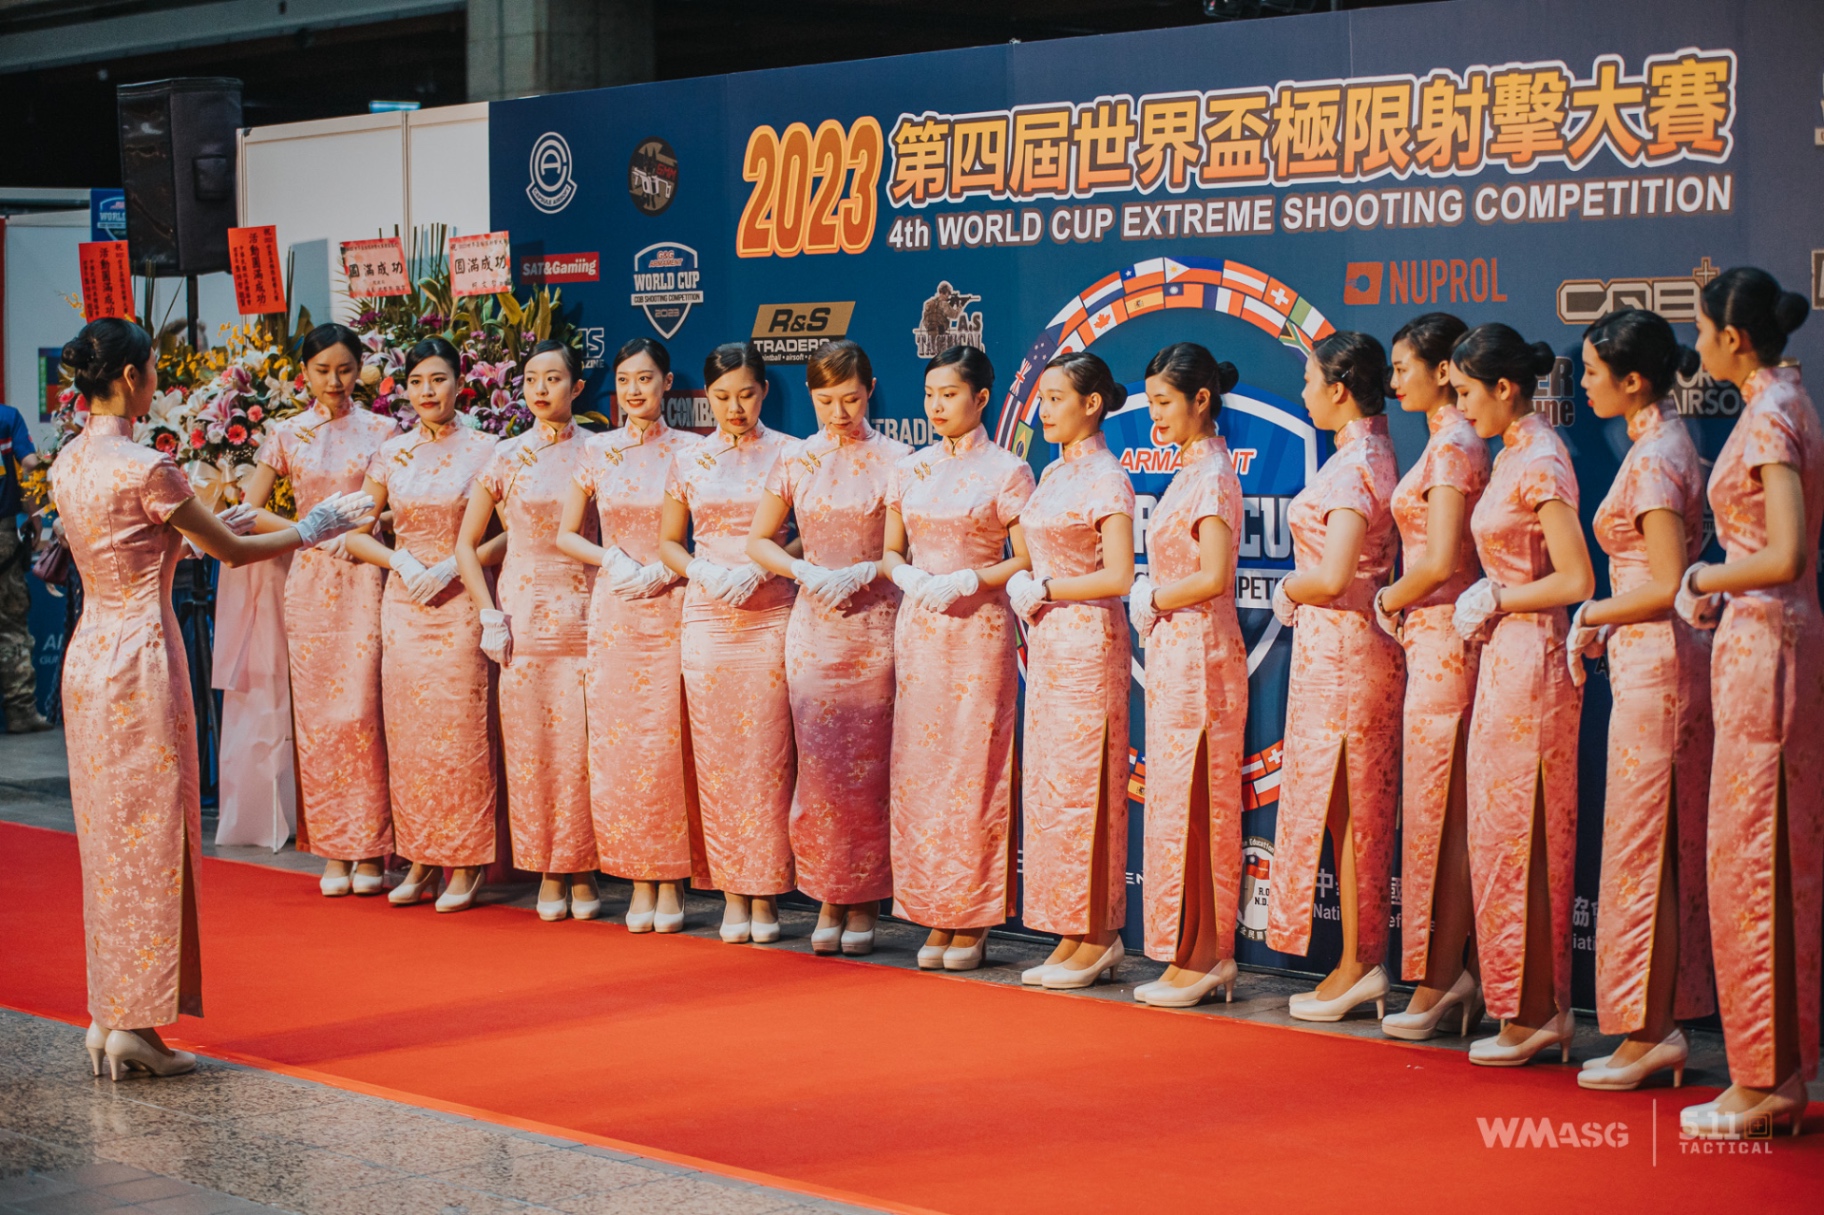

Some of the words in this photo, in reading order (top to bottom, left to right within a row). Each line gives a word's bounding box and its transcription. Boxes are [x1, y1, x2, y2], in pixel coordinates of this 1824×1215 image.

[736, 116, 884, 258] 2023
[892, 52, 1734, 200] 第四屆世界盃極限射擊大賽
[889, 220, 928, 248] 4th
[938, 212, 1042, 245] WORLD
[1051, 209, 1114, 240] CUP
[1122, 199, 1273, 237] EXTREME
[1282, 190, 1463, 229] SHOOTING
[1475, 176, 1731, 221] COMPETITION
[349, 261, 403, 279] 圓滿成功
[455, 255, 507, 275] 圓滿成功
[633, 272, 675, 292] WORLD
[677, 271, 700, 290] CUP
[1390, 257, 1507, 304] NUPROL
[646, 293, 668, 303] SHOOTING
[668, 292, 700, 302] COMPETITION
[768, 306, 831, 333] R&S
[667, 397, 719, 427] COMBA
[872, 419, 942, 446] TRADE
